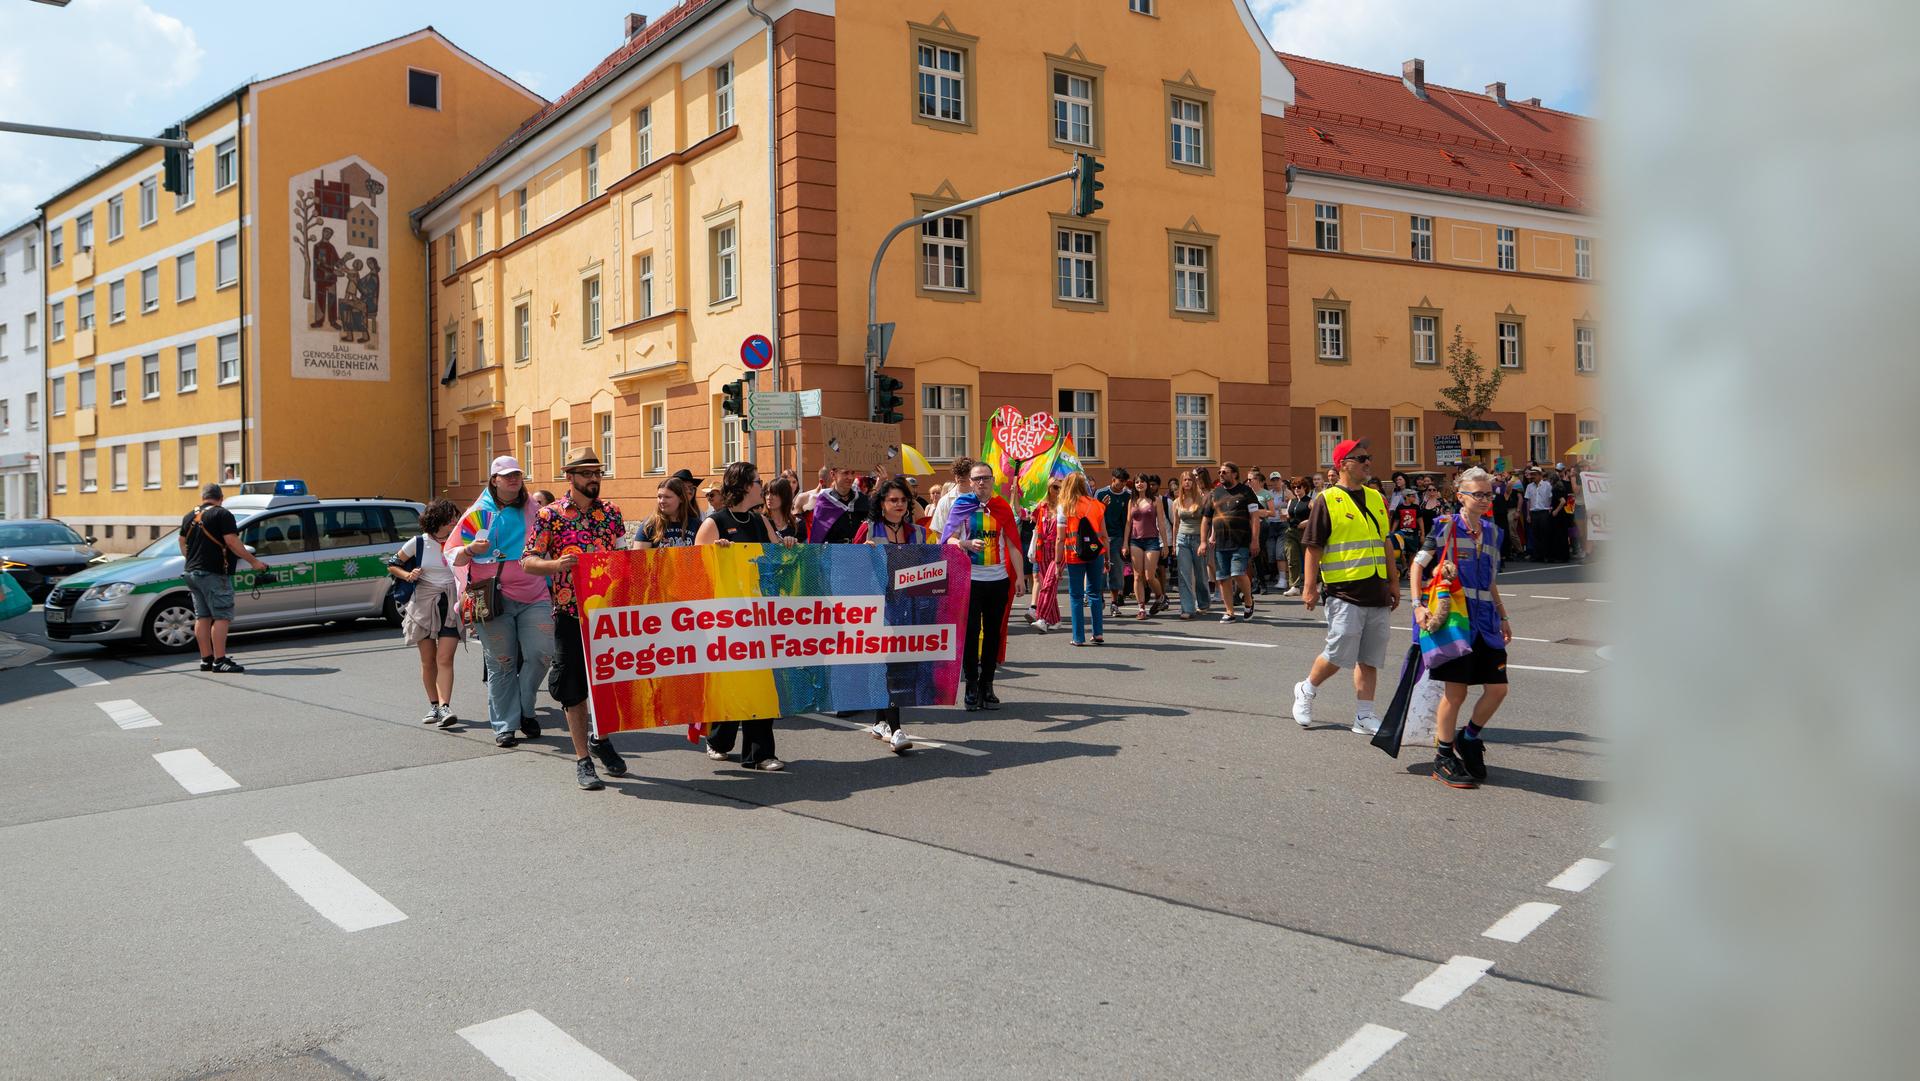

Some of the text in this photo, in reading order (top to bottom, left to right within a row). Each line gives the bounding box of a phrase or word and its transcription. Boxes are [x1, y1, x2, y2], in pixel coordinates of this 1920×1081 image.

[302, 350, 379, 362] GENOSSENSCHAFT
[332, 344, 349, 353] BAU
[304, 358, 379, 371] FAMILIENHEIM
[998, 427, 1046, 446] GEGEN
[1005, 441, 1035, 459] HASS
[899, 572, 916, 585] Die
[593, 600, 878, 640] Alle Geschlechter
[595, 629, 949, 680] gegen den Faschismus!
